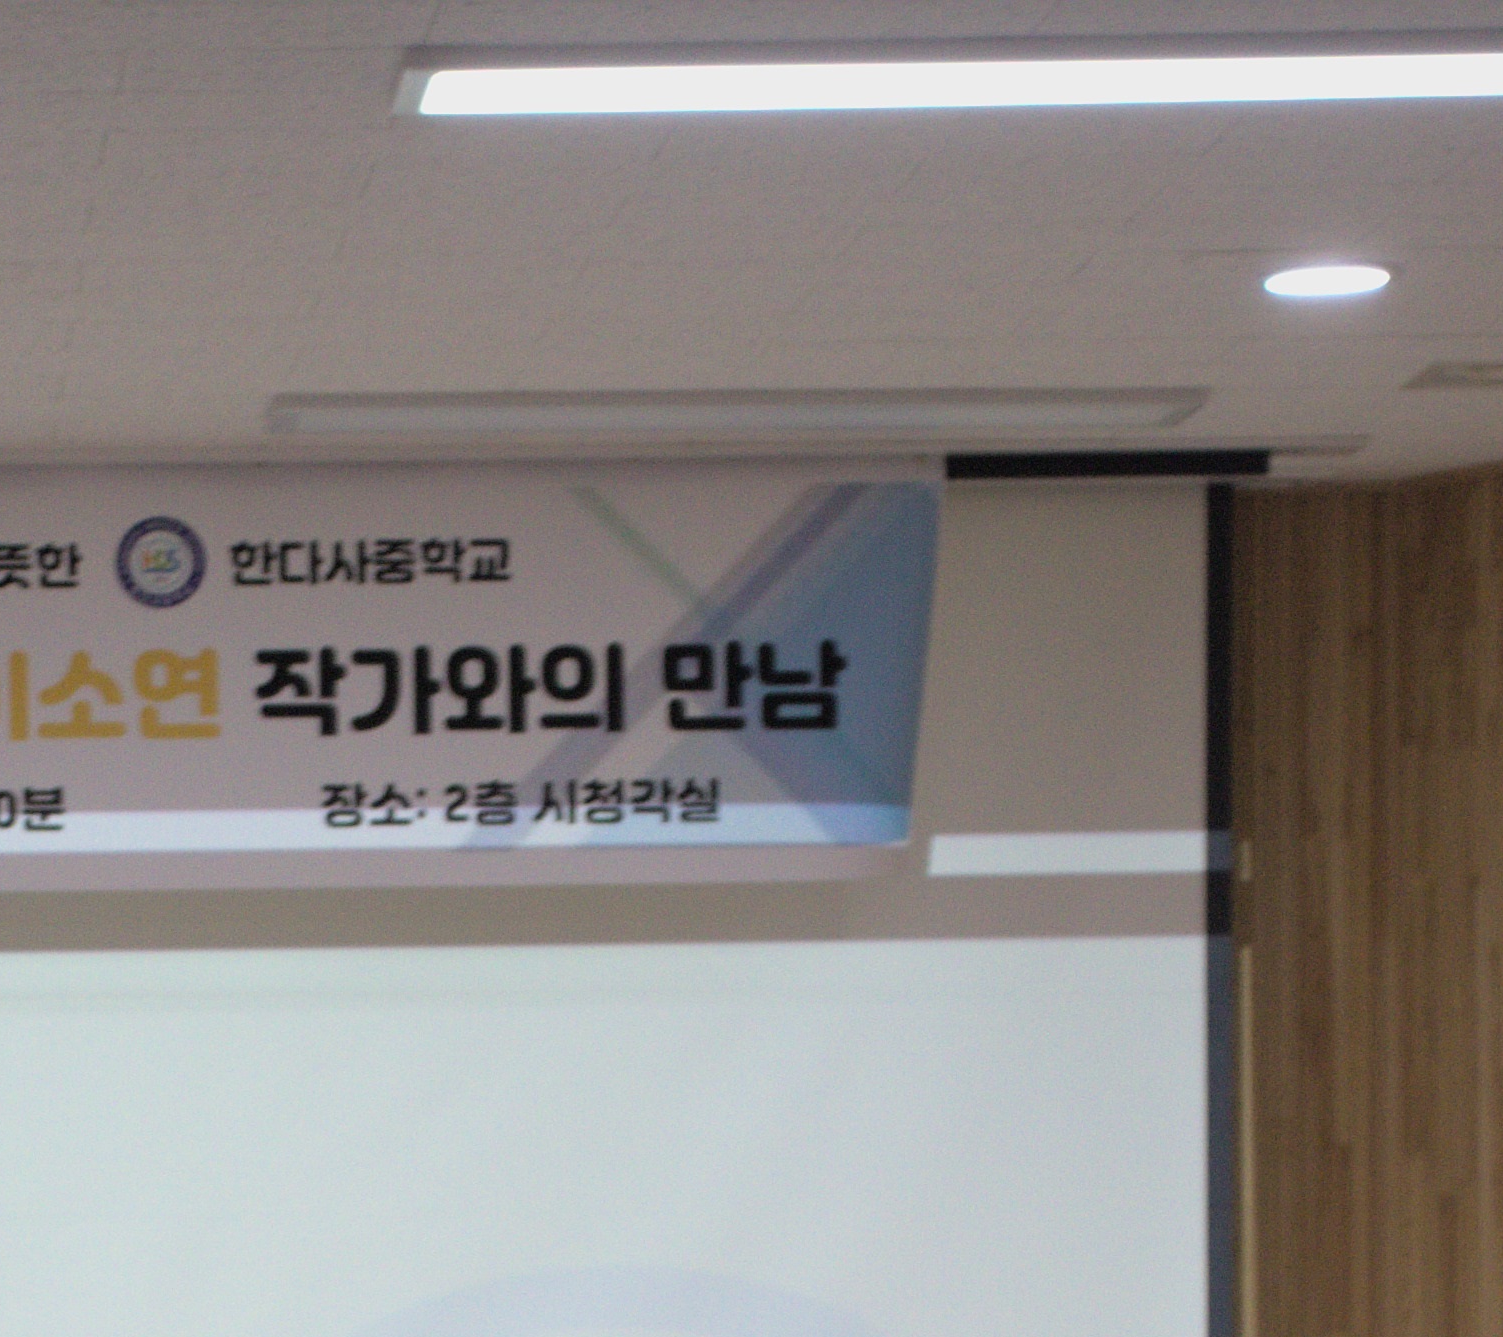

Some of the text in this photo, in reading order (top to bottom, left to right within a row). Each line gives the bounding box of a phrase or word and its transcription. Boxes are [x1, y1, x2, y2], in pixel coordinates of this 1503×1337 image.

[230, 539, 509, 586] 한다사중학교
[256, 643, 623, 736] 작가와의
[663, 640, 846, 732] 만남
[323, 779, 719, 828] 장소: 2층 시청각실
